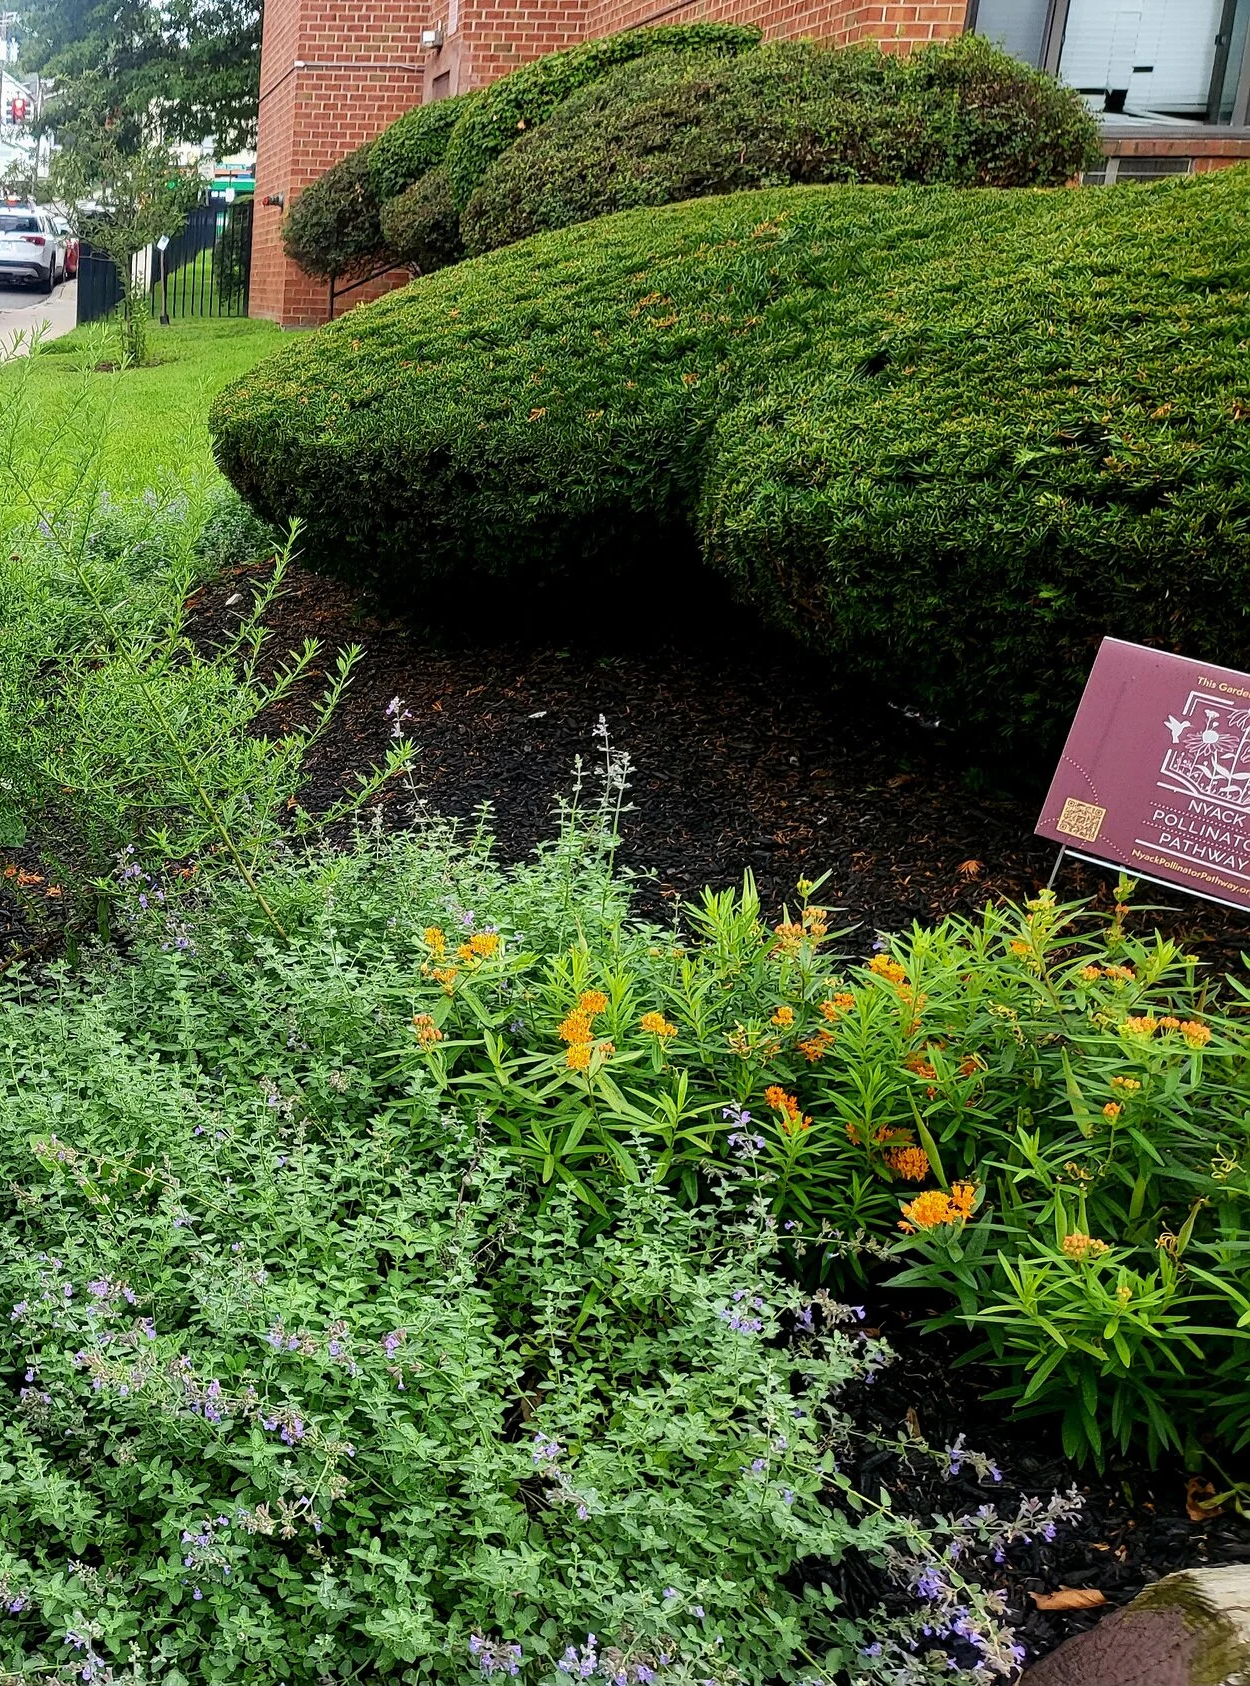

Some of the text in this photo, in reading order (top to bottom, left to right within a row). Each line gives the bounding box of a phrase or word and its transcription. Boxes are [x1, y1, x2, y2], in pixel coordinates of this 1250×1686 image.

[1197, 676, 1250, 698] This Garde
[1187, 799, 1247, 828] NYACK
[1158, 832, 1250, 871] PATHWAY
